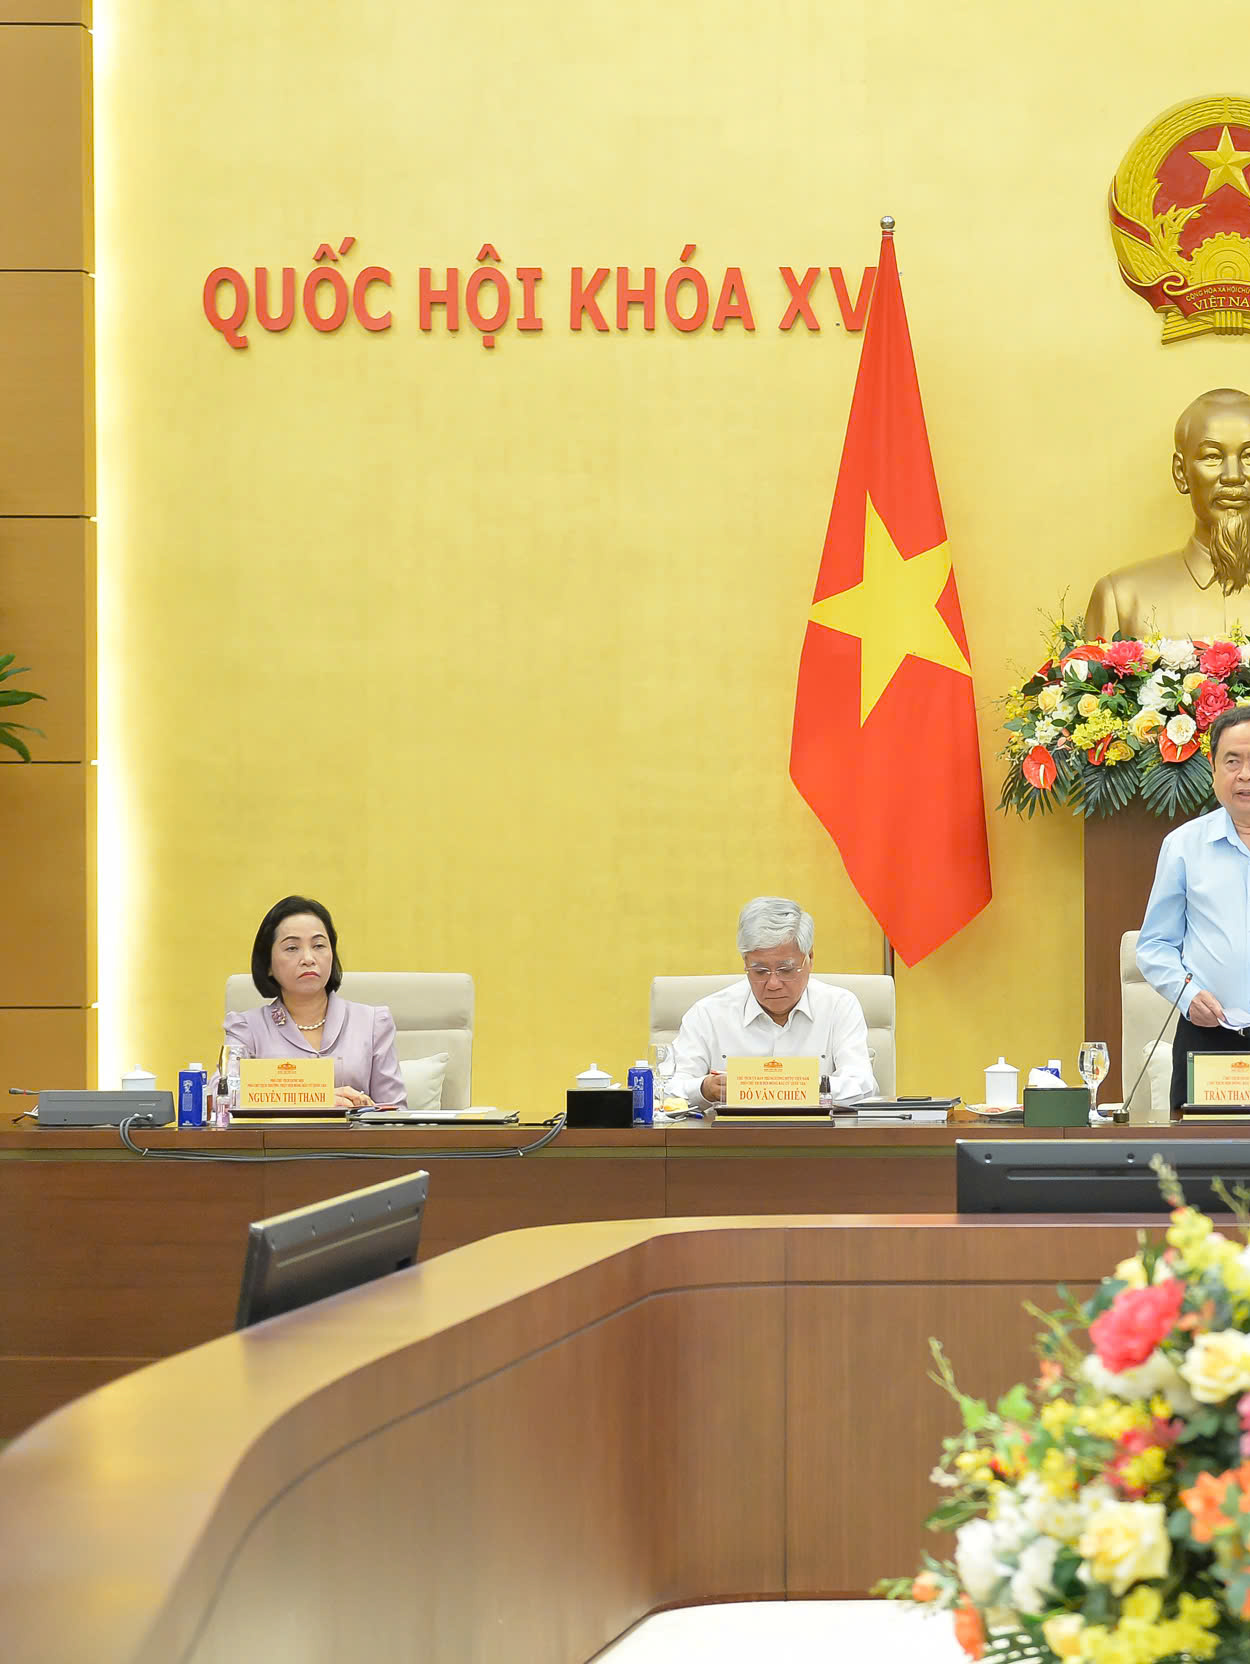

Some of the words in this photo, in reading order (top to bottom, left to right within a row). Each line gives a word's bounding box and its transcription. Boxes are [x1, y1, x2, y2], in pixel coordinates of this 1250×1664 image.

[203, 237, 392, 348] QUỐC
[419, 243, 543, 348] HỘI
[570, 244, 755, 332] KHÓA
[779, 267, 878, 332] XV
[298, 1092, 326, 1103] THANH
